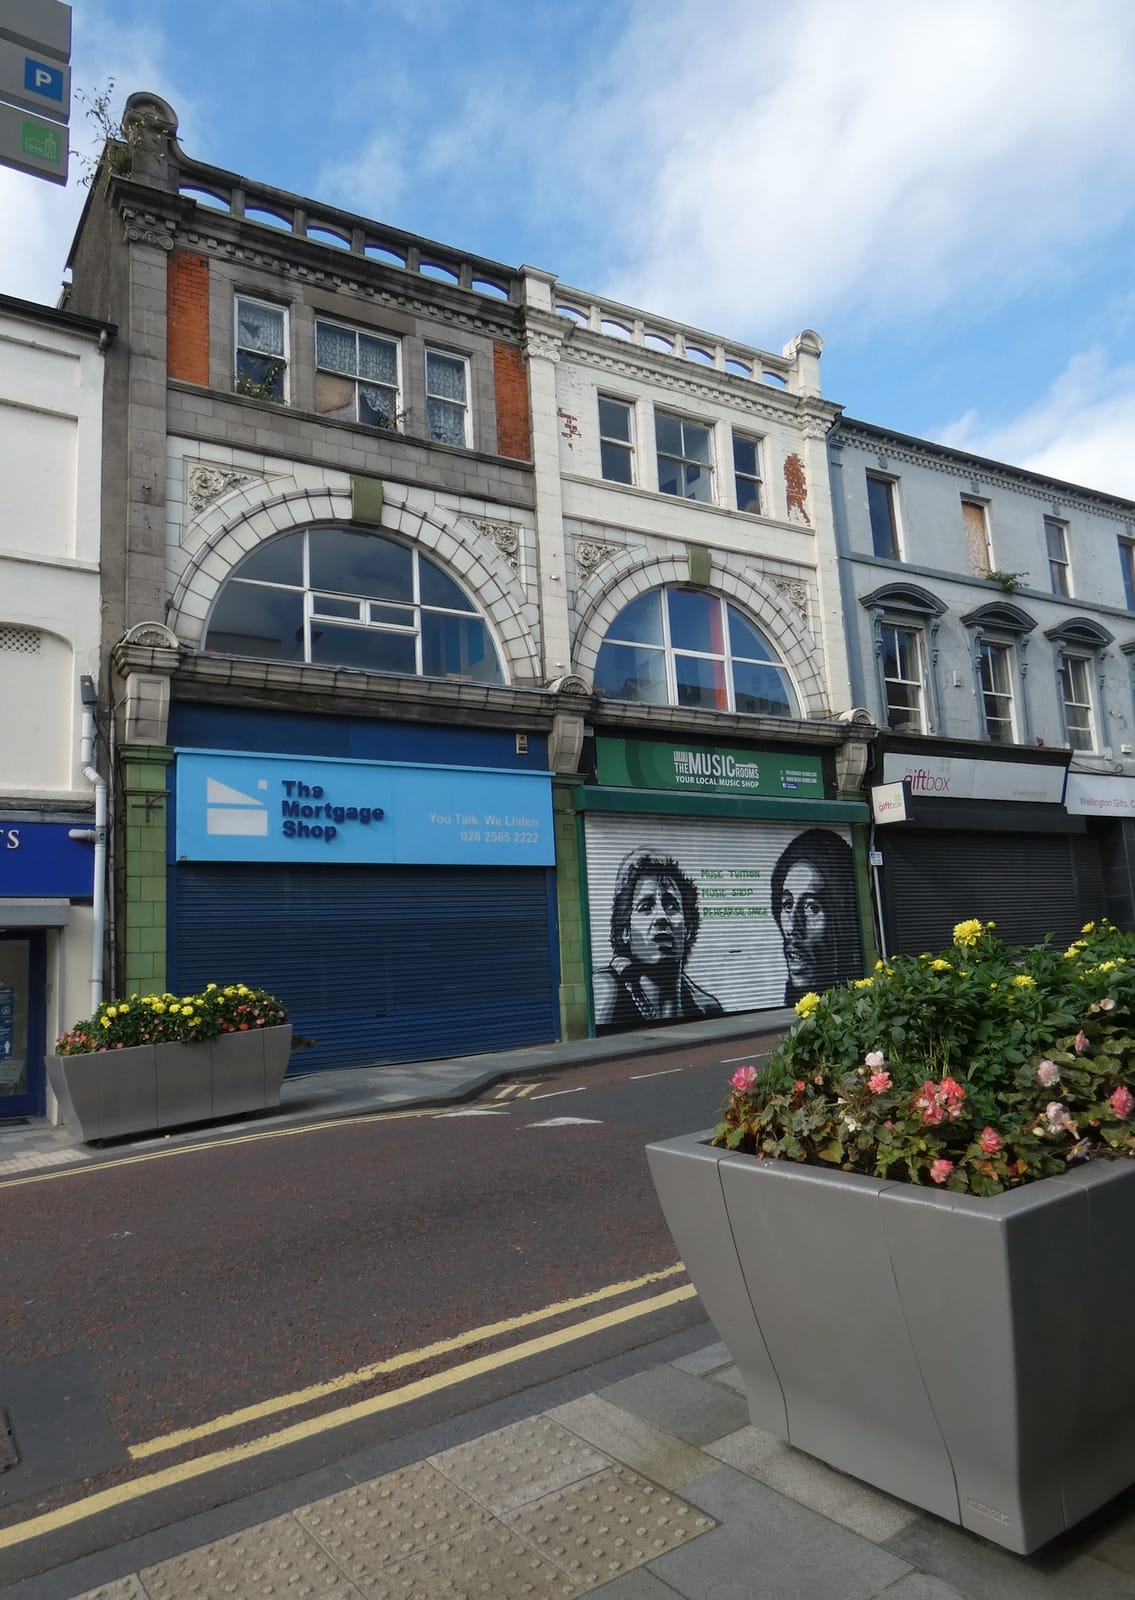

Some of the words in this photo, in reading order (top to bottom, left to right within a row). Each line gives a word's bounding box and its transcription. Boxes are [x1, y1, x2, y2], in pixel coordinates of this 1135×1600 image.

[35, 68, 52, 87] P
[674, 762, 688, 774] THE
[688, 752, 735, 777] MUSIC
[735, 767, 760, 779] ROOMS
[675, 775, 695, 784] YOUR
[696, 777, 718, 786] LOCAL
[719, 779, 740, 787] MUSIC
[741, 780, 760, 788] SHOP
[281, 780, 325, 799] The
[281, 800, 385, 825] Mortgage
[879, 800, 902, 813] giftbox
[429, 813, 452, 824] You
[484, 815, 502, 826] We
[505, 815, 539, 828] Listen
[282, 820, 337, 843] Shop
[460, 831, 481, 842] 028
[484, 831, 511, 843] 2565
[513, 832, 539, 844] 2222
[701, 869, 723, 878] MUSIC
[728, 869, 760, 878] TUITION
[702, 888, 725, 897] MUSIC
[731, 888, 753, 897] SHOP
